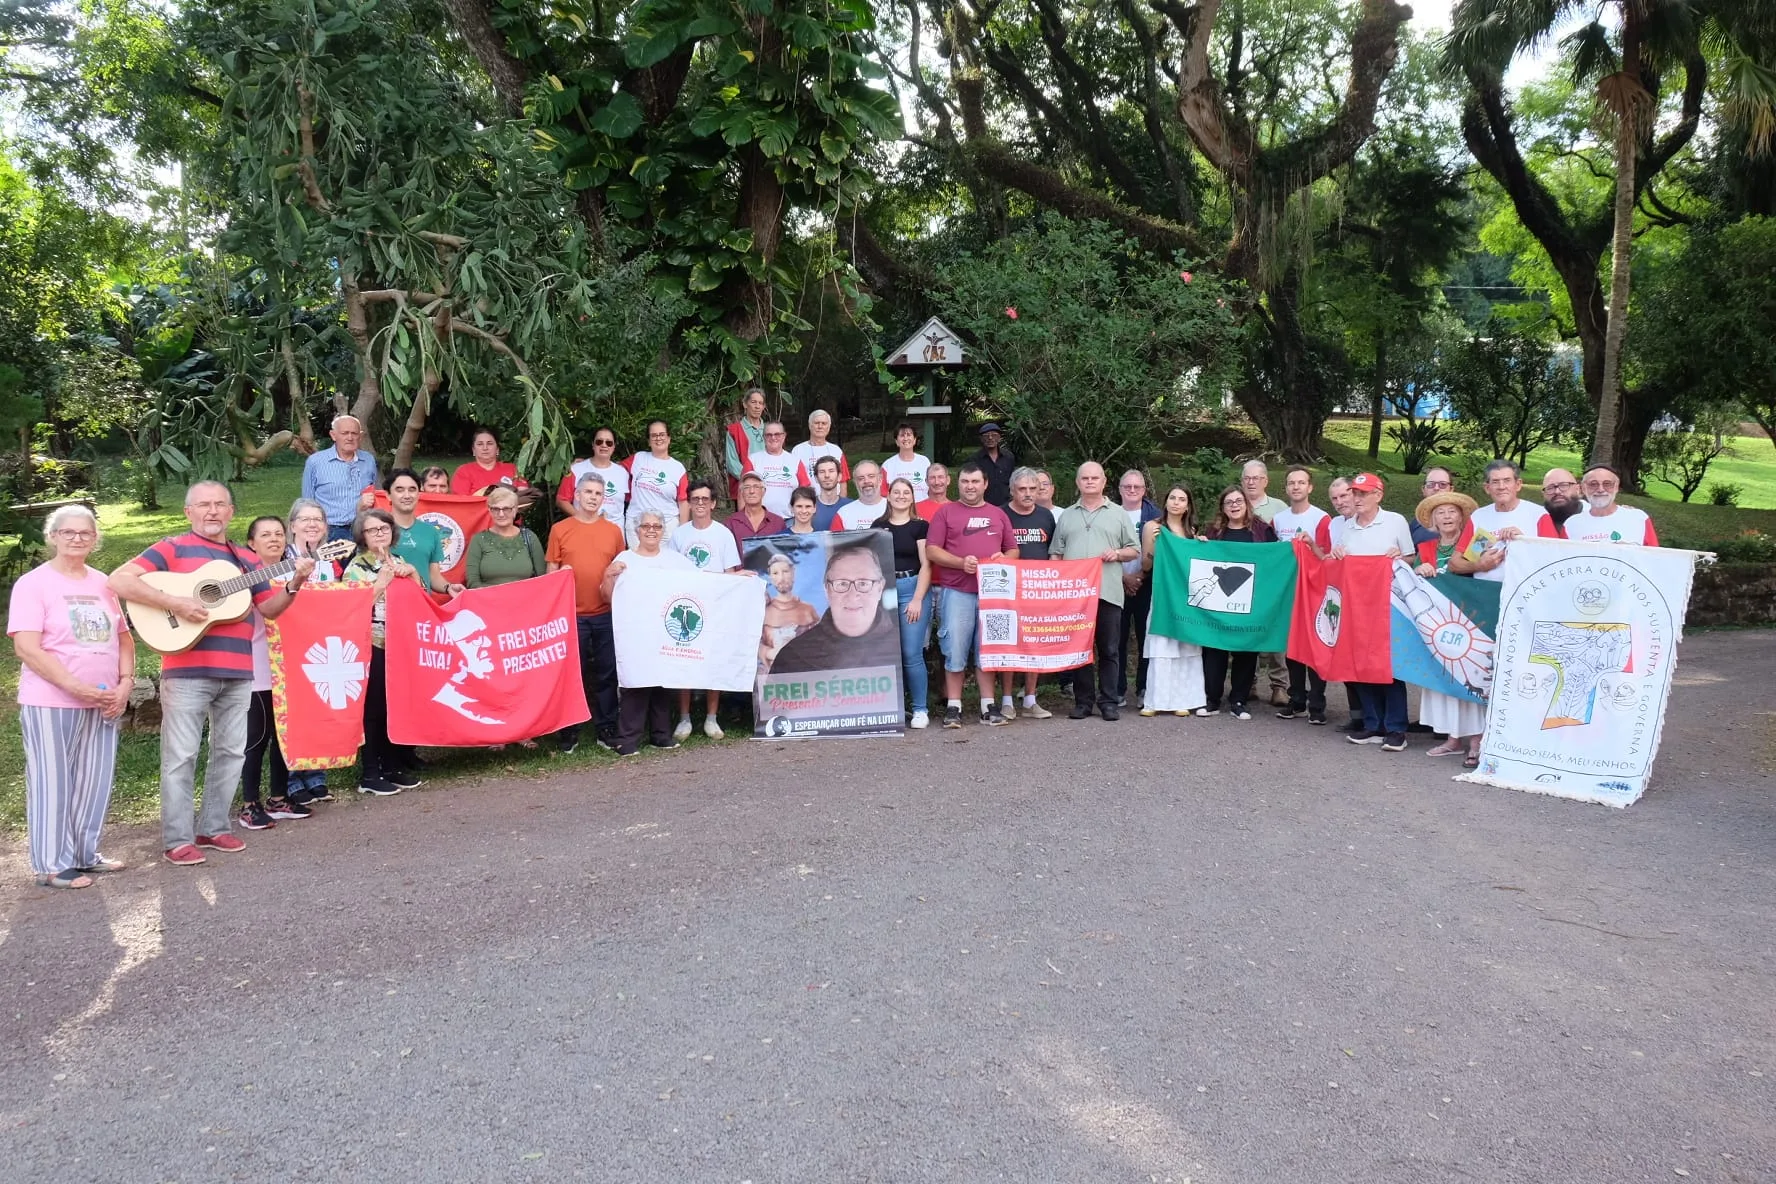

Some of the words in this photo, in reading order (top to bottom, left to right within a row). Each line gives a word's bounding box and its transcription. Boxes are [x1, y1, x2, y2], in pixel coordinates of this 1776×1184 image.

[967, 517, 991, 528] NIKE
[1582, 532, 1609, 541] MISSÃO
[1021, 567, 1059, 579] MISSÃO
[1550, 565, 1593, 581] TERRA
[1599, 566, 1627, 583] QUE
[1021, 579, 1071, 589] SEMENTES
[1075, 578, 1088, 588] DE
[1021, 587, 1097, 600] SOLIDARIEDADE
[1628, 583, 1651, 608] NOS
[1226, 602, 1247, 612] CPT
[1516, 605, 1524, 614] A
[1020, 615, 1038, 624] FAÇA
[416, 620, 432, 643] FÉ
[434, 625, 454, 646] NA
[497, 629, 527, 651] FREI
[529, 616, 569, 645] SERGIO
[1440, 630, 1464, 646] EJR
[1643, 612, 1661, 678] SUSTENTA
[419, 647, 452, 670] LUTA!
[502, 640, 568, 676] PRESENTE!
[763, 681, 809, 702] FREI
[814, 674, 892, 699] SÉRGIO
[794, 718, 840, 731] ESPERANÇAR
[840, 717, 856, 727] COM
[867, 716, 878, 726] NA
[878, 714, 898, 724] LUTA!
[1495, 708, 1508, 735] PELA
[1629, 695, 1650, 755] GOVERNA
